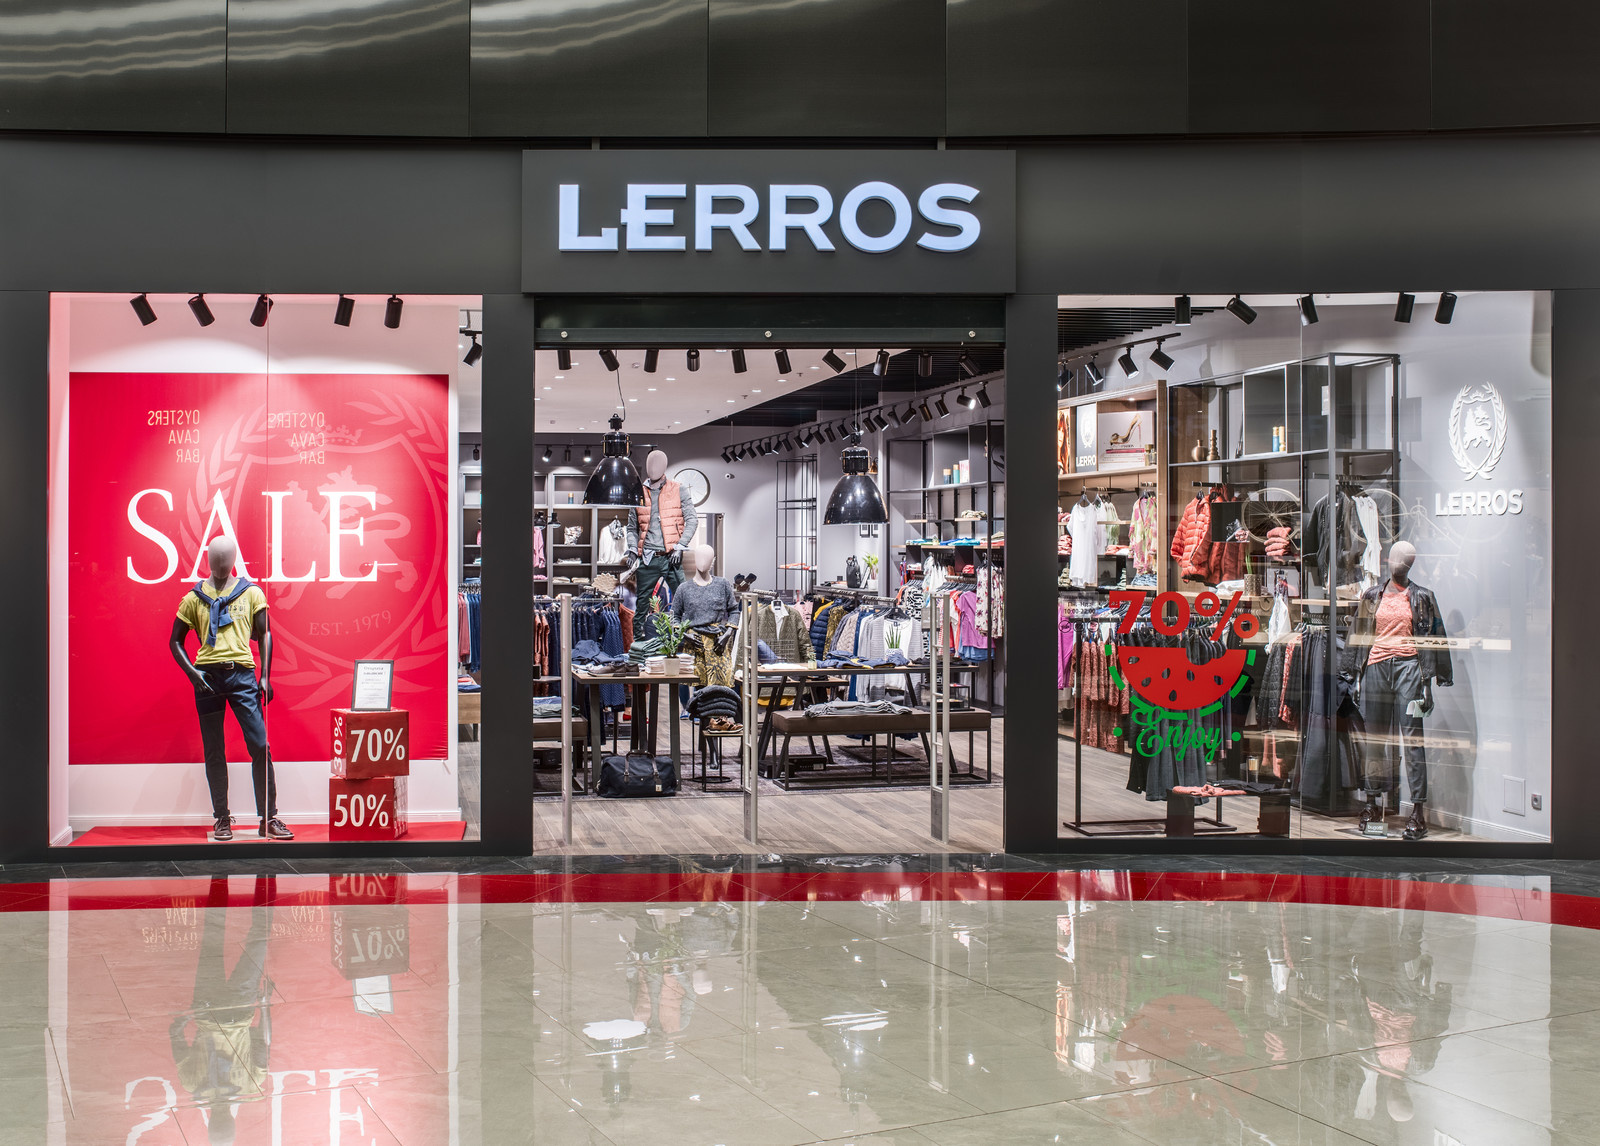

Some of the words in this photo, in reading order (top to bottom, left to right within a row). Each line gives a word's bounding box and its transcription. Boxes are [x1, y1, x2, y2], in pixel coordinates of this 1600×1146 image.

[558, 181, 982, 253] LERROS
[1435, 489, 1523, 517] LERROS
[127, 487, 379, 585] SALE
[1108, 590, 1260, 641] 70%
[333, 716, 343, 773] 30%
[350, 727, 405, 763] 70%
[1131, 706, 1223, 762] Enjoy
[334, 793, 389, 828] 50%
